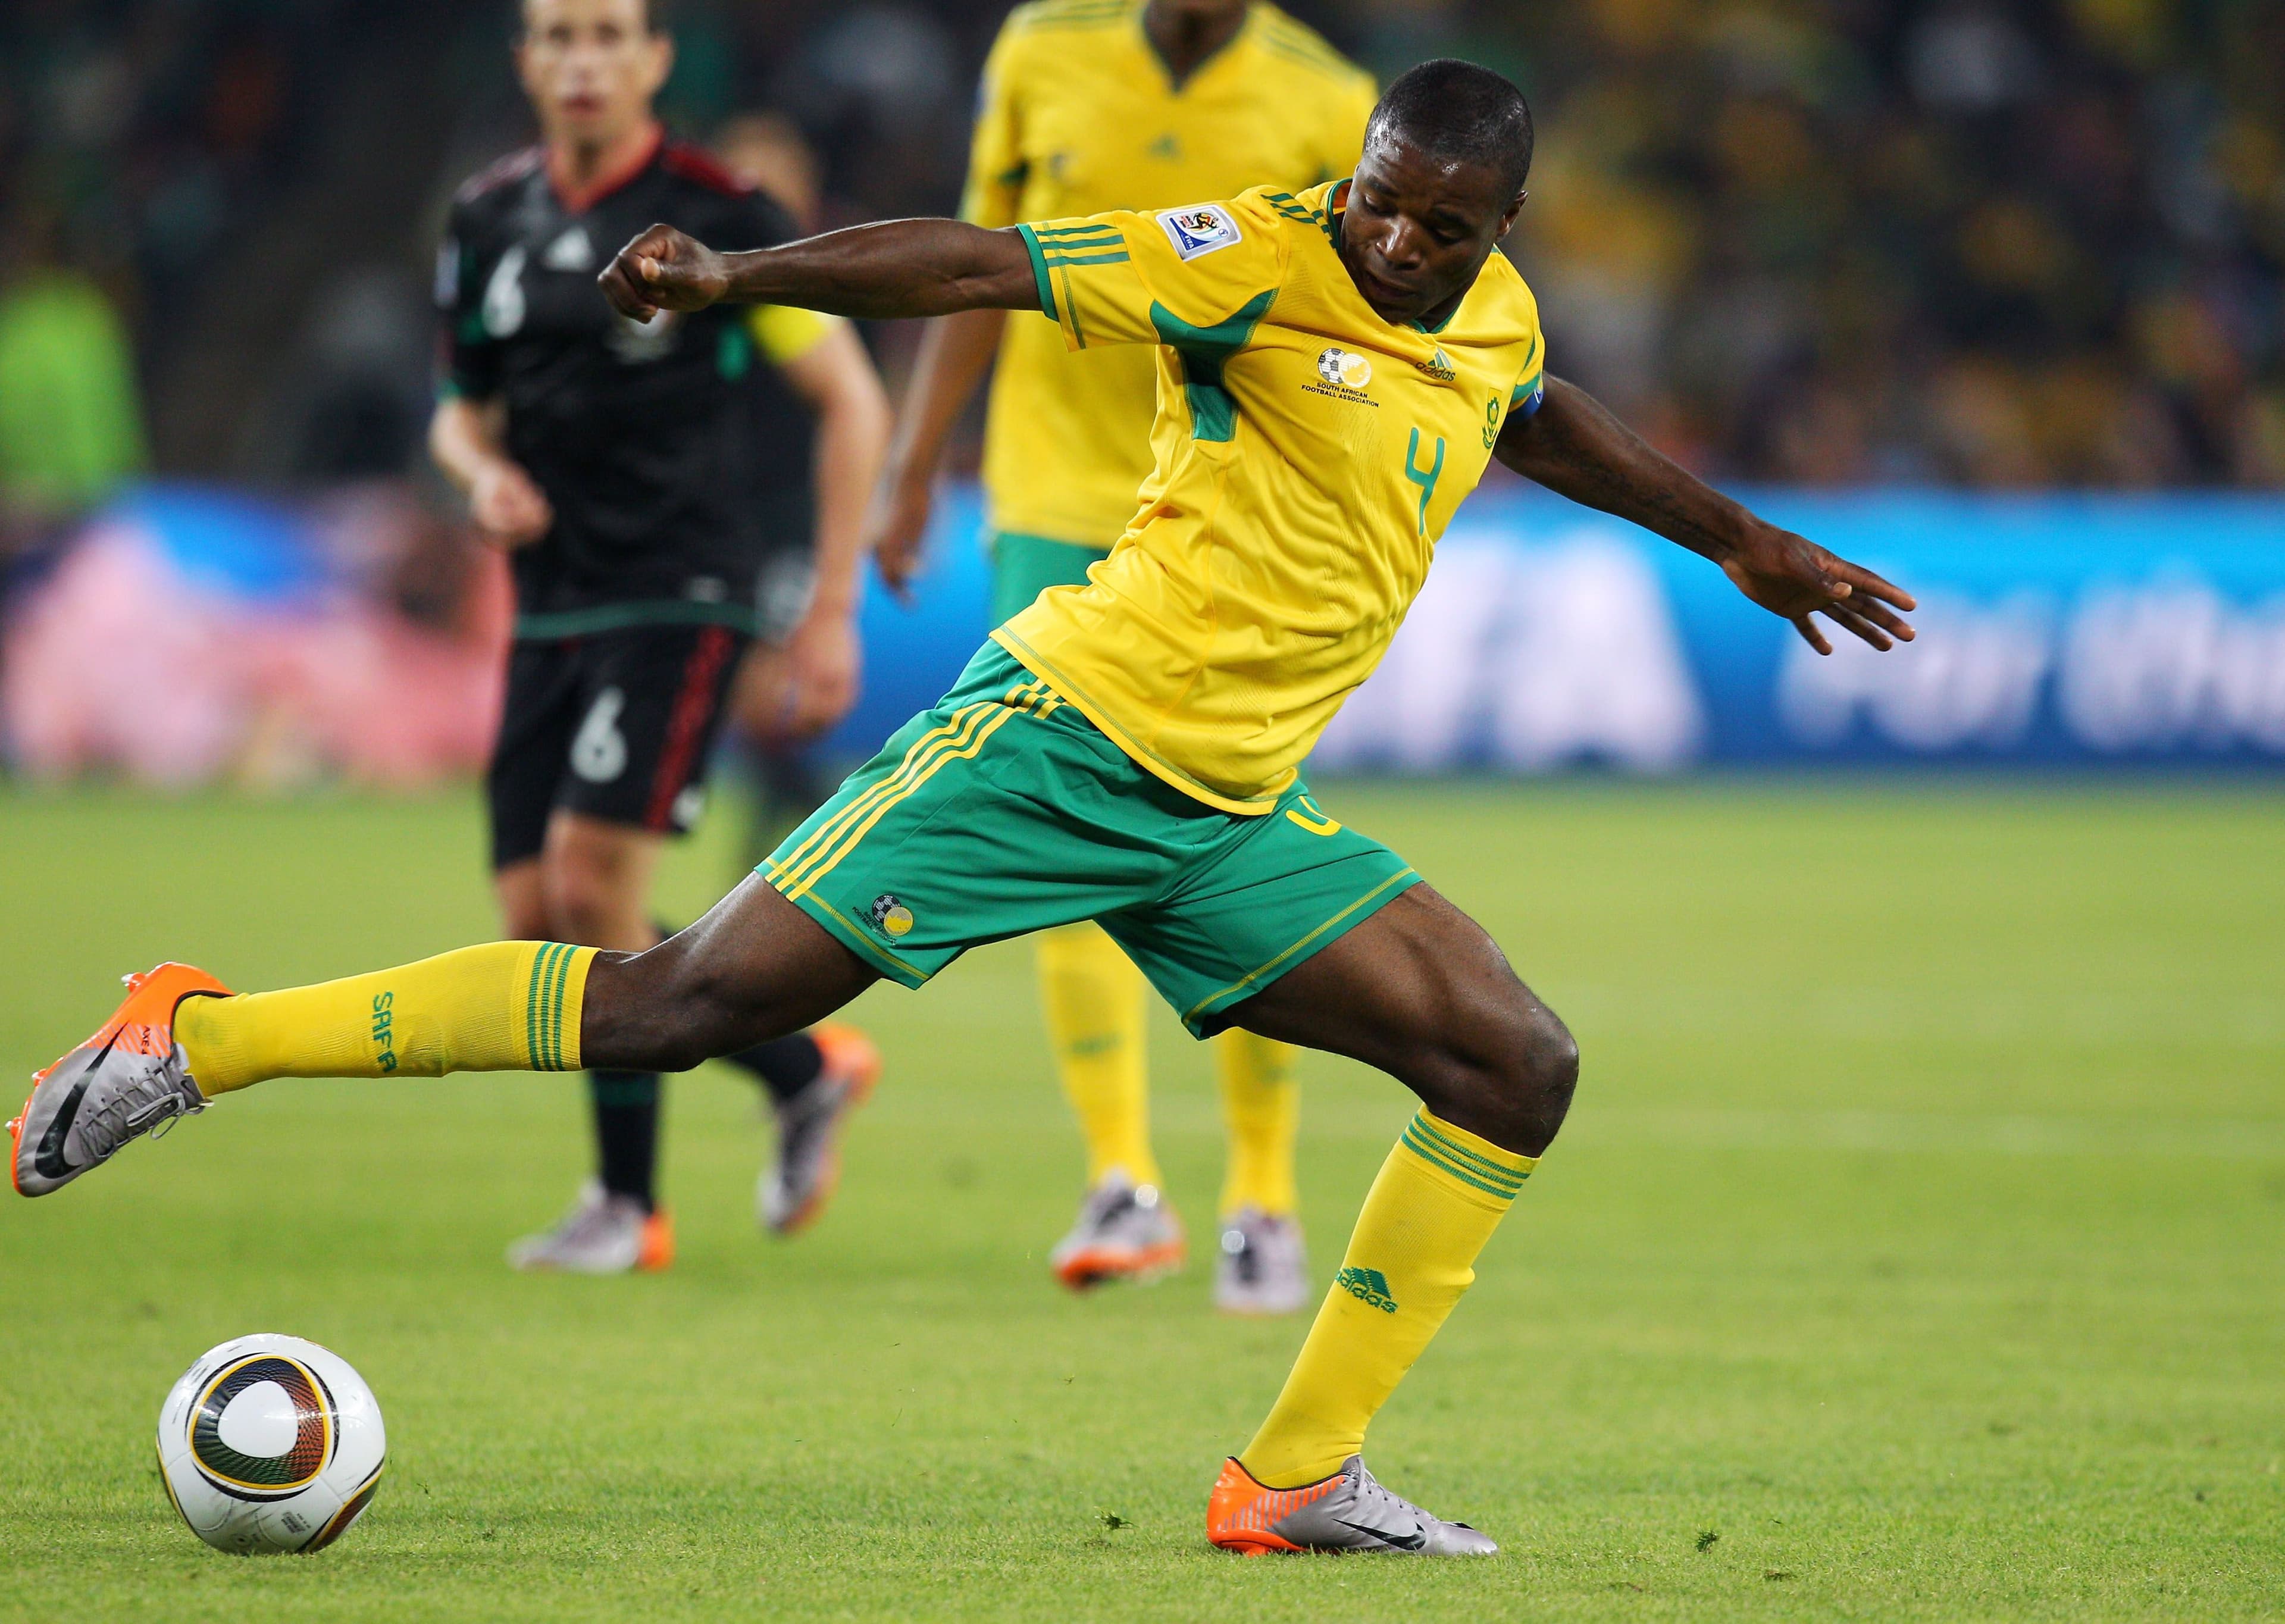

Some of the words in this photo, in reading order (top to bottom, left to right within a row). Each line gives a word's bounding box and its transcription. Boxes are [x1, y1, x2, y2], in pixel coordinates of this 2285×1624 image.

[481, 243, 527, 339] 6
[1301, 384, 1336, 398] FOOTBALL
[1339, 393, 1379, 408] ASSOCIATION
[1317, 382, 1339, 392] SOUTH
[1341, 387, 1368, 398] AFRICAN
[1416, 362, 1455, 381] adidas
[1406, 427, 1445, 536] 4
[569, 684, 627, 784] 6
[373, 991, 397, 1073] SAFA
